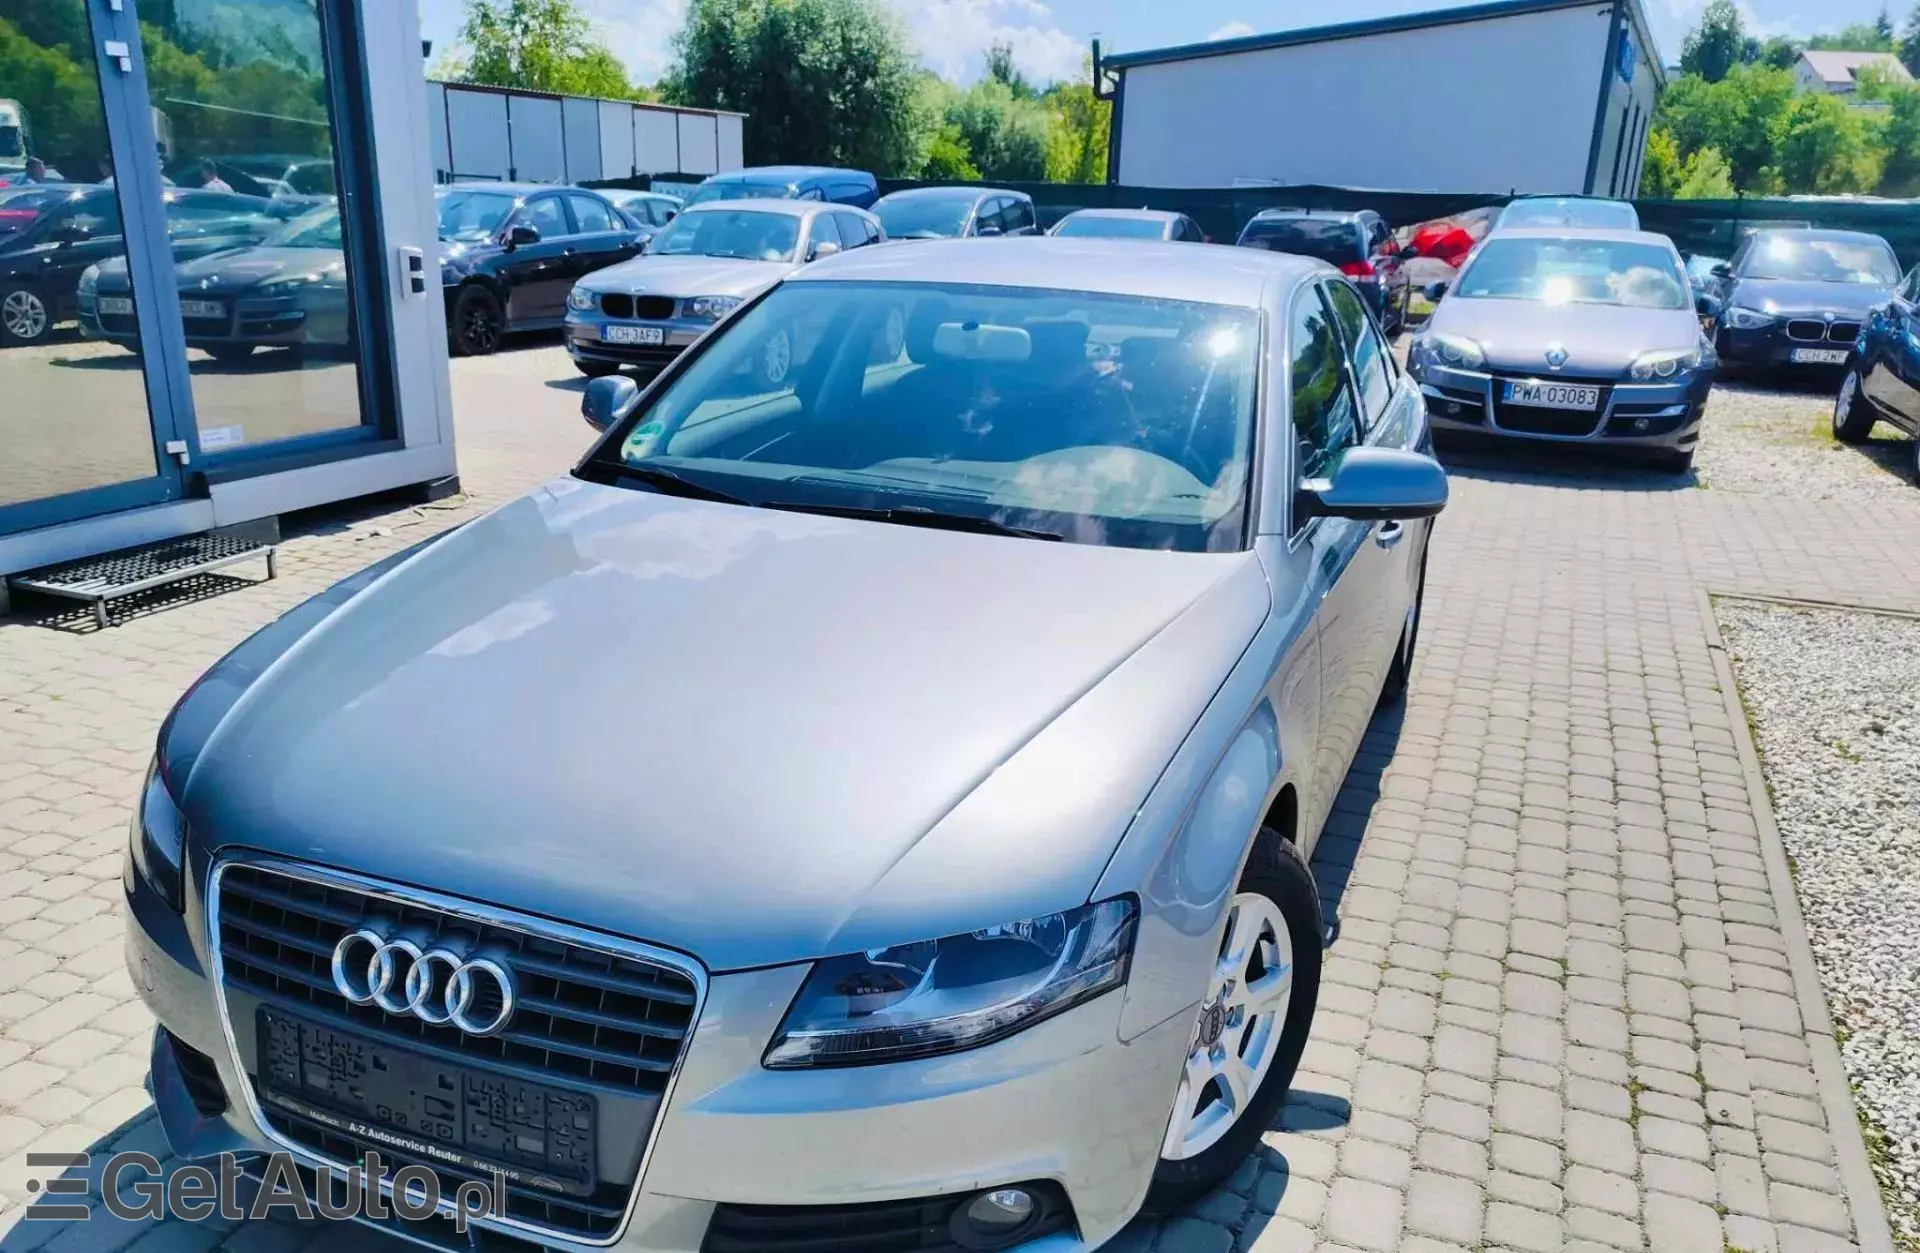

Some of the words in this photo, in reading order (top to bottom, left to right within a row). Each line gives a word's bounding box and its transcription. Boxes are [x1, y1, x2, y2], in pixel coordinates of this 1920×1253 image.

[608, 327, 629, 341] CCH
[631, 328, 660, 342] 3AF9
[1512, 385, 1541, 401] PWA
[1547, 387, 1597, 405] 03083
[349, 1122, 367, 1136] A-Z
[367, 1128, 427, 1152] Autoservice
[427, 1144, 462, 1164] Reuter
